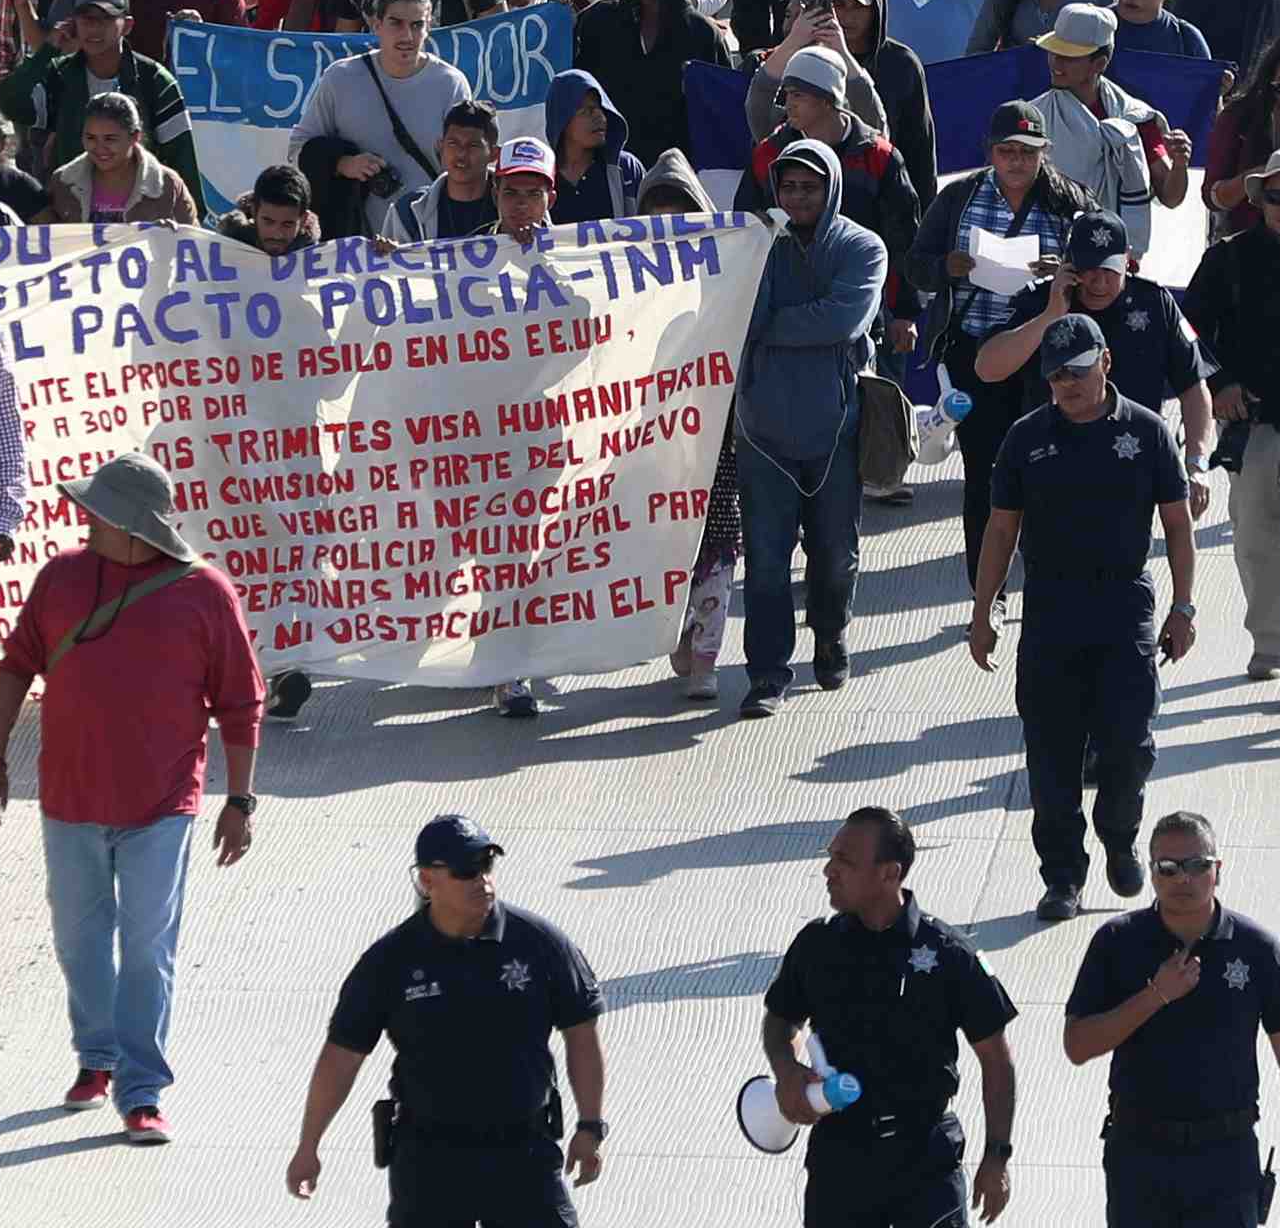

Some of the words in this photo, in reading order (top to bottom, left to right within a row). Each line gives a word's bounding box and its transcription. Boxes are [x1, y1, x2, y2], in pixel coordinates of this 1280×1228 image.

[173, 27, 241, 115] EL
[174, 239, 238, 283] AL
[73, 291, 282, 354] PACTO
[85, 371, 117, 400] EL
[121, 355, 241, 394] PROCESO
[252, 351, 284, 383] DE
[298, 340, 393, 379] ASILO
[406, 334, 449, 369] EN
[457, 326, 511, 364] LOS
[54, 416, 71, 438] A
[80, 404, 128, 434] 300
[141, 395, 193, 426] POR
[203, 393, 248, 421] DIA
[210, 419, 393, 466] TRAMITES
[404, 410, 482, 445] VISA
[496, 350, 735, 438] HUMANITARIA
[218, 468, 355, 506] COMISION
[369, 463, 401, 492] DE
[409, 452, 513, 490] PARTE
[527, 438, 584, 473] DEL
[599, 406, 702, 460] NUEVO
[206, 513, 268, 542] QUE
[277, 504, 378, 536] VENGA
[396, 500, 419, 529] A
[433, 472, 616, 528] NEGOCIAR
[311, 538, 436, 573] POLICIA
[450, 503, 632, 559] MUNICIPAL
[236, 577, 393, 613] PERSONAS
[404, 541, 611, 600] MIGRANTES
[274, 620, 313, 651] NI
[323, 588, 597, 645] OBSTACULICEN
[607, 575, 655, 619] EL
